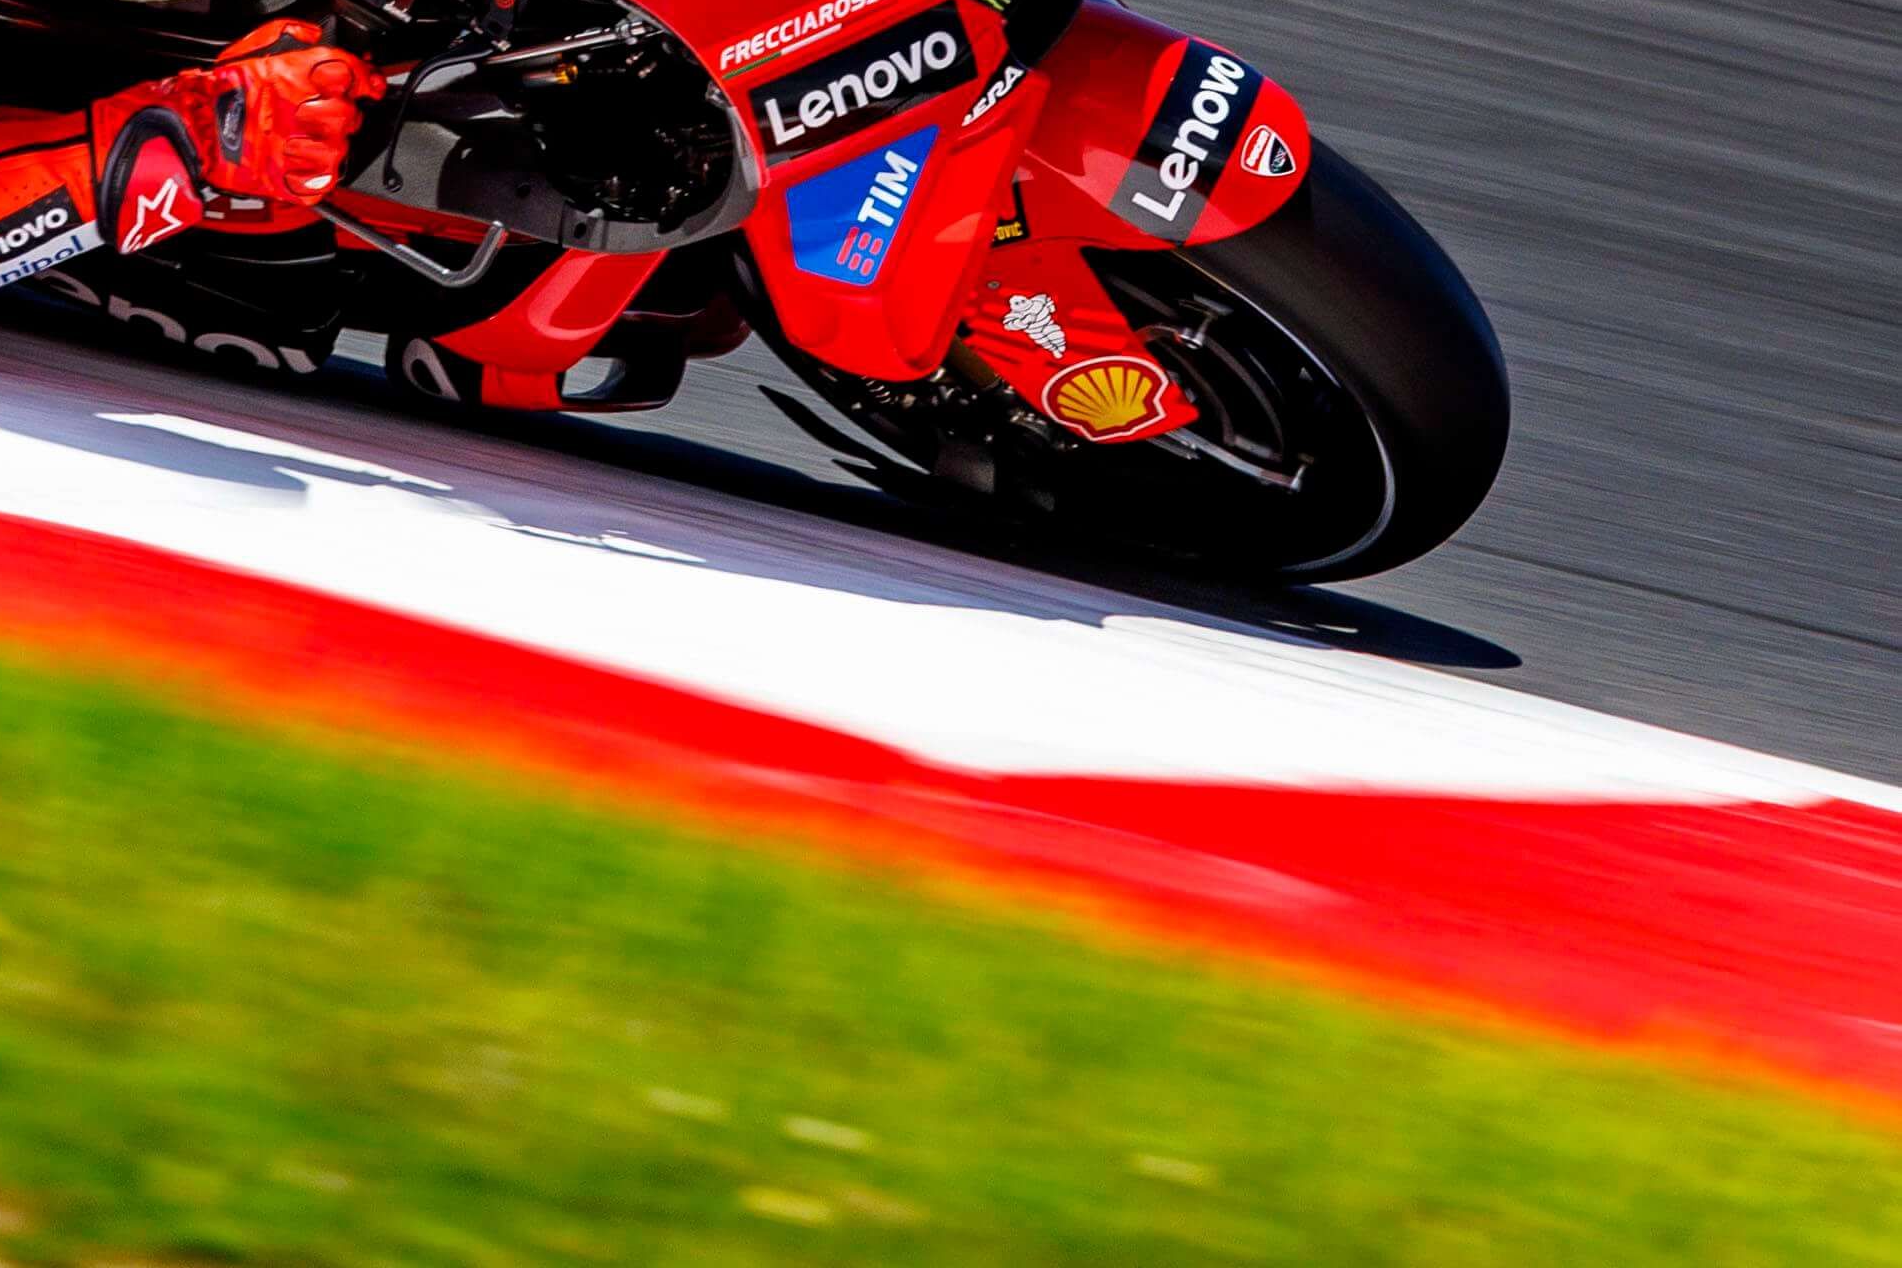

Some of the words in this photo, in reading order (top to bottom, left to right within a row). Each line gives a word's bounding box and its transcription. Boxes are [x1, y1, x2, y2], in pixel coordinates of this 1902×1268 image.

[764, 31, 958, 146] Lenovo
[1131, 55, 1246, 222] Lenovo
[857, 150, 918, 228] TIM
